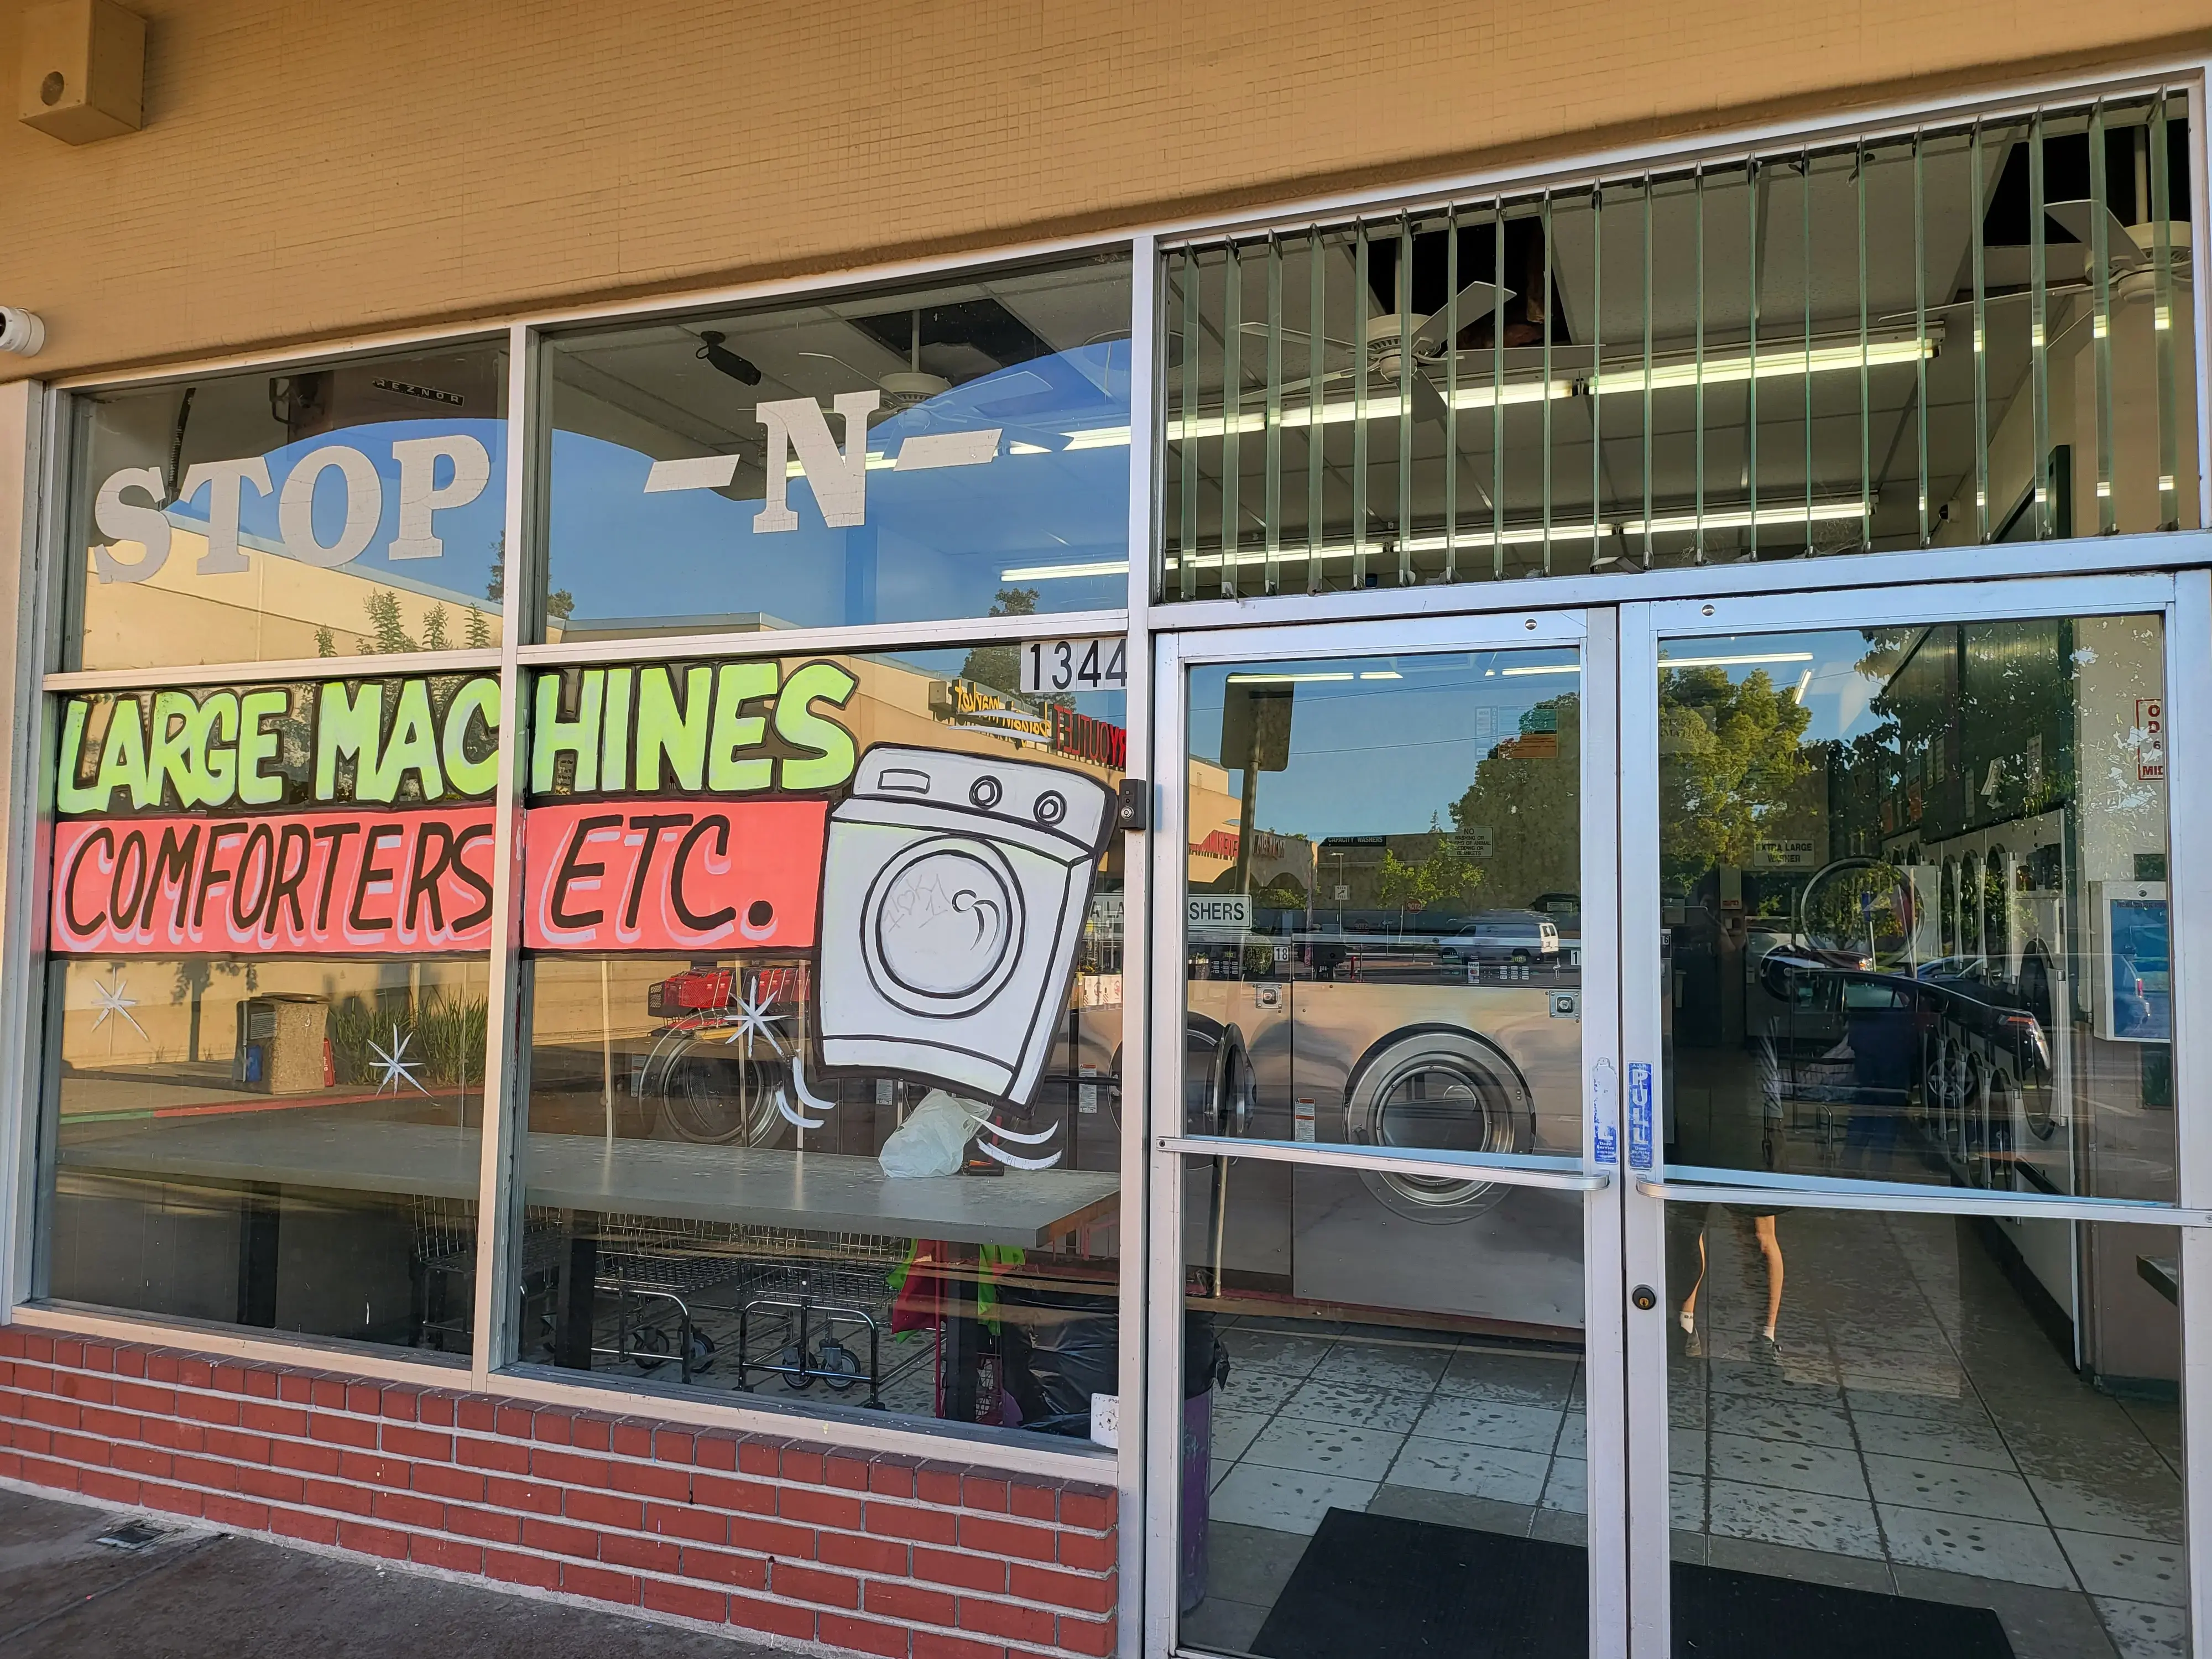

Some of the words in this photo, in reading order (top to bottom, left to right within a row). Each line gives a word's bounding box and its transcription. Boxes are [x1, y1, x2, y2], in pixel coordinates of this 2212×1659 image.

[93, 435, 491, 584] STOP
[1030, 638, 1127, 691] 1344
[56, 687, 292, 814] LARGE
[311, 659, 860, 806] MACHINES
[62, 821, 494, 937] COMFORTERS
[551, 813, 774, 931] ETC.
[1785, 843, 1812, 851] LARGE
[1275, 947, 1288, 961] 18
[1632, 1068, 1648, 1145] PULL
